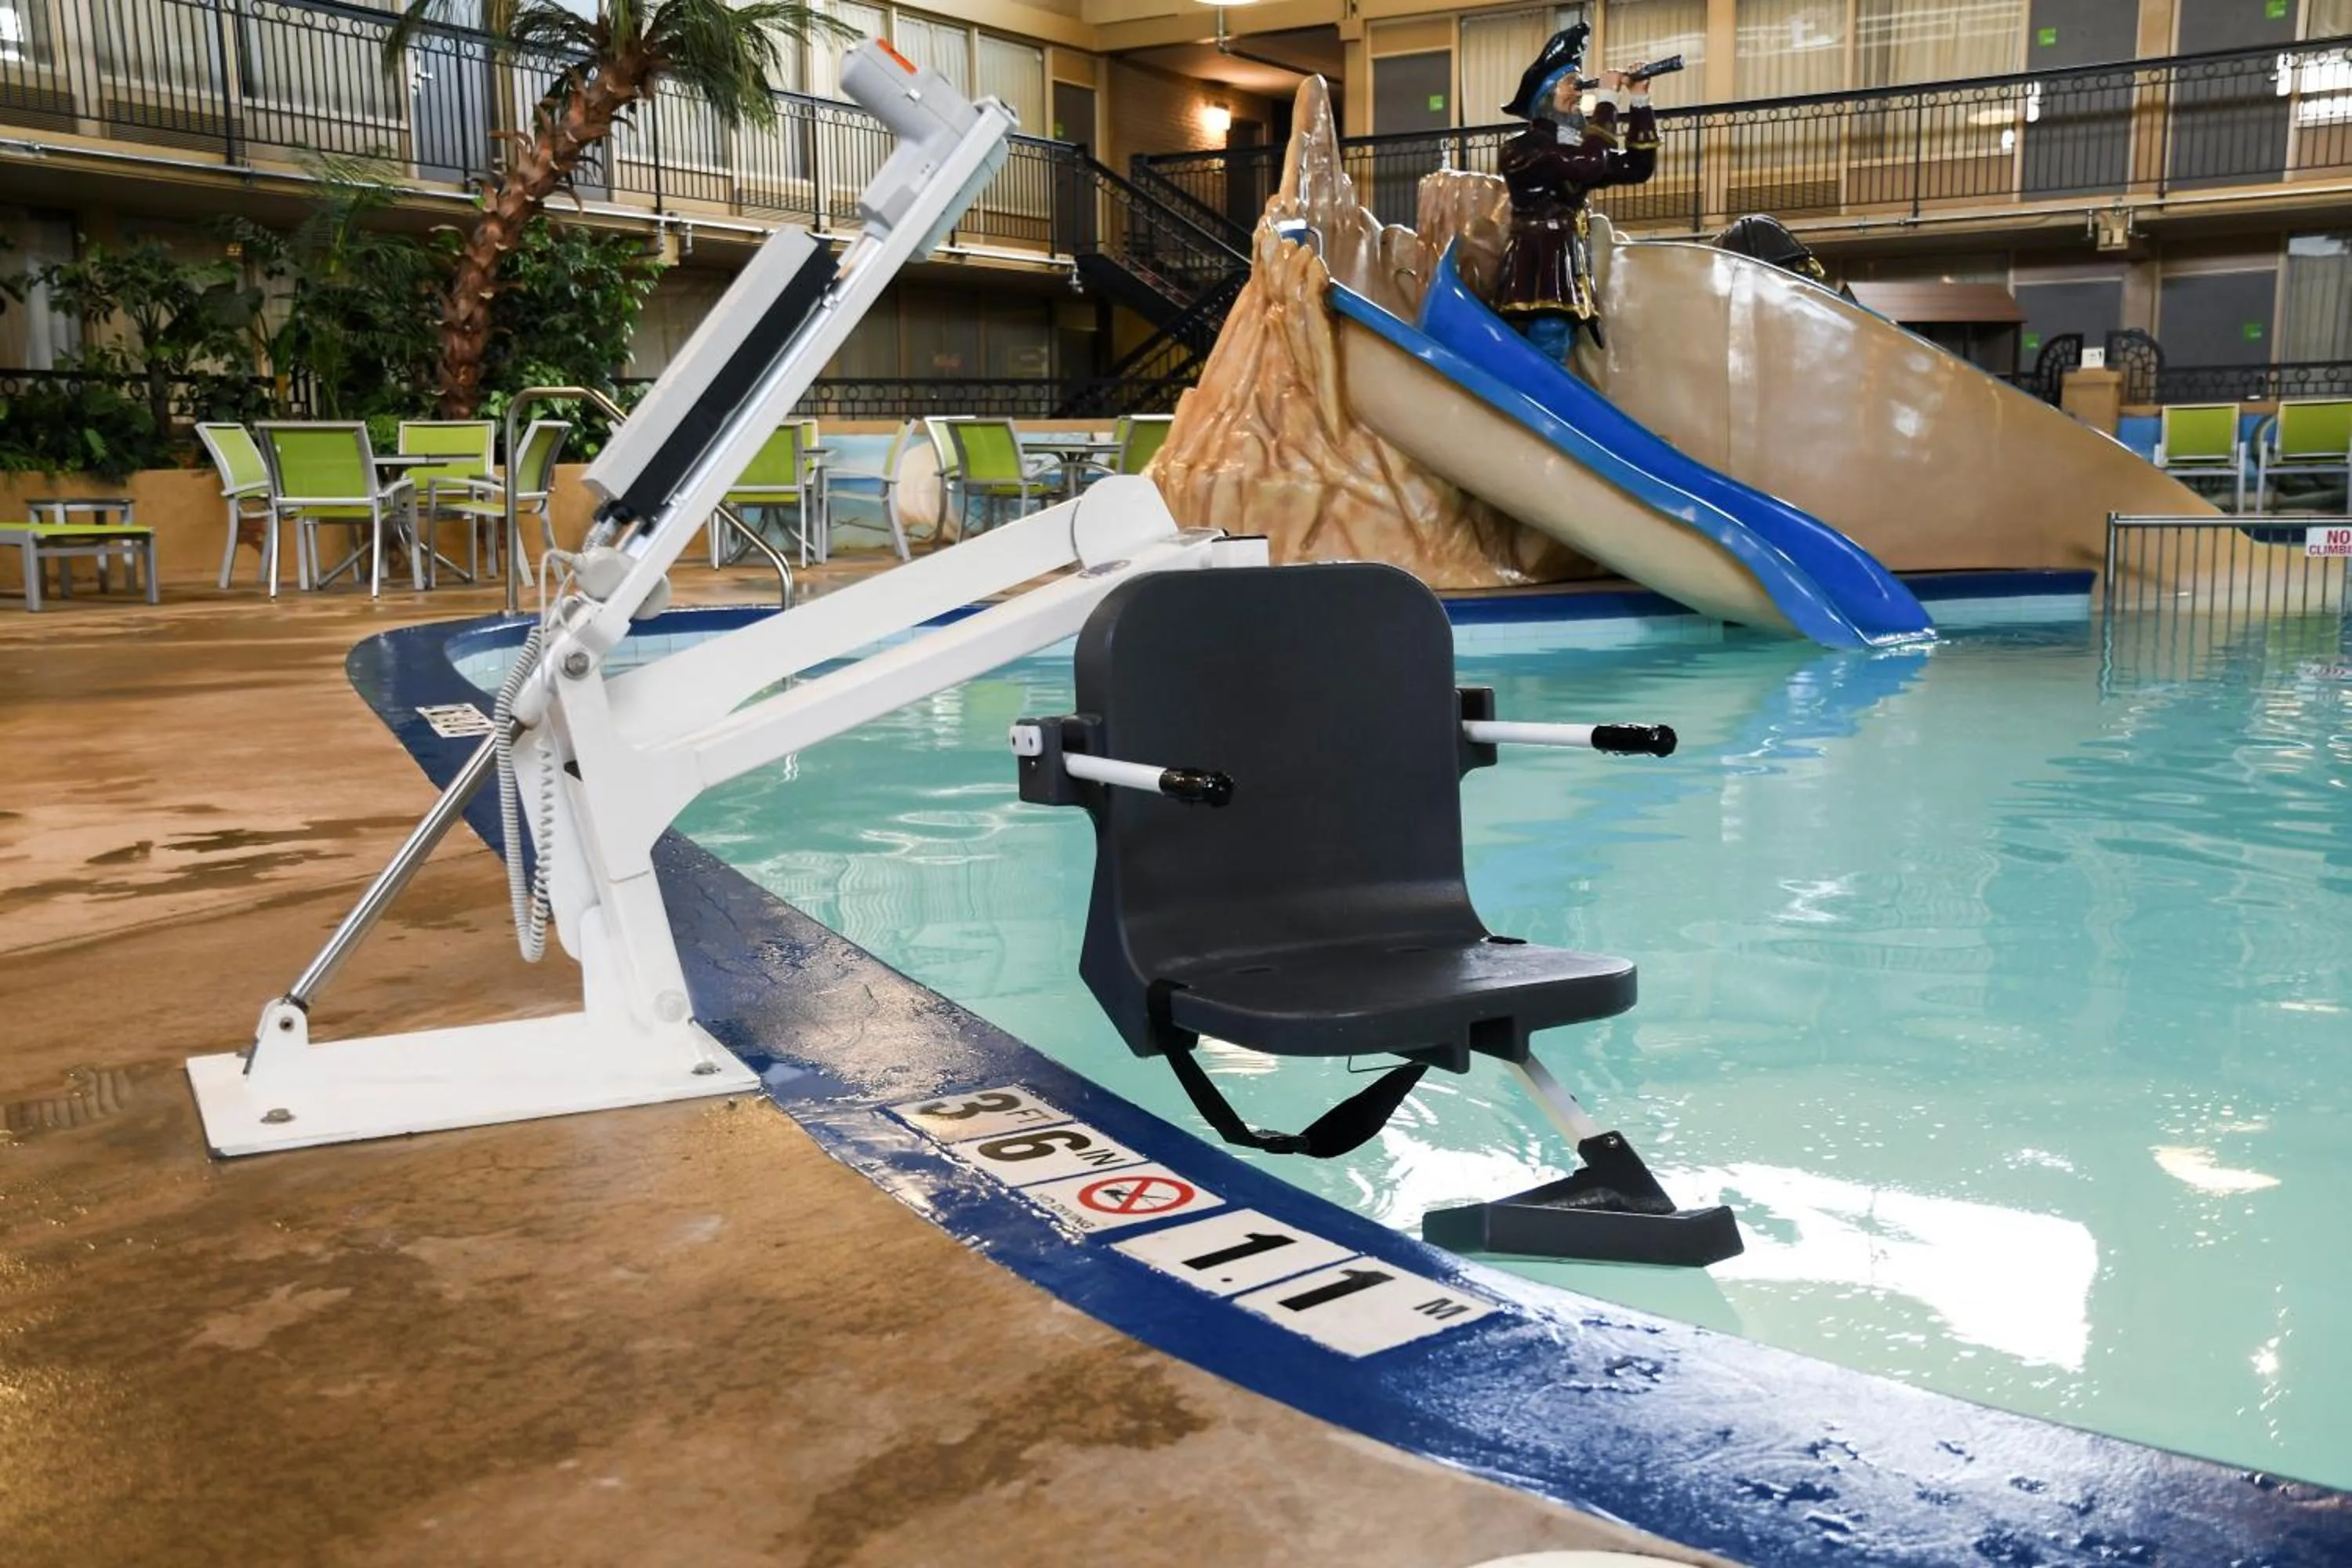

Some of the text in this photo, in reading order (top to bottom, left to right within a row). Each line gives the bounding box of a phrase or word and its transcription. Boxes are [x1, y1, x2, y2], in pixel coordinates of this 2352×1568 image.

[2327, 529, 2350, 545] NO
[916, 1092, 1125, 1167] 3 FT 6 IN
[1413, 1298, 1471, 1321] M
